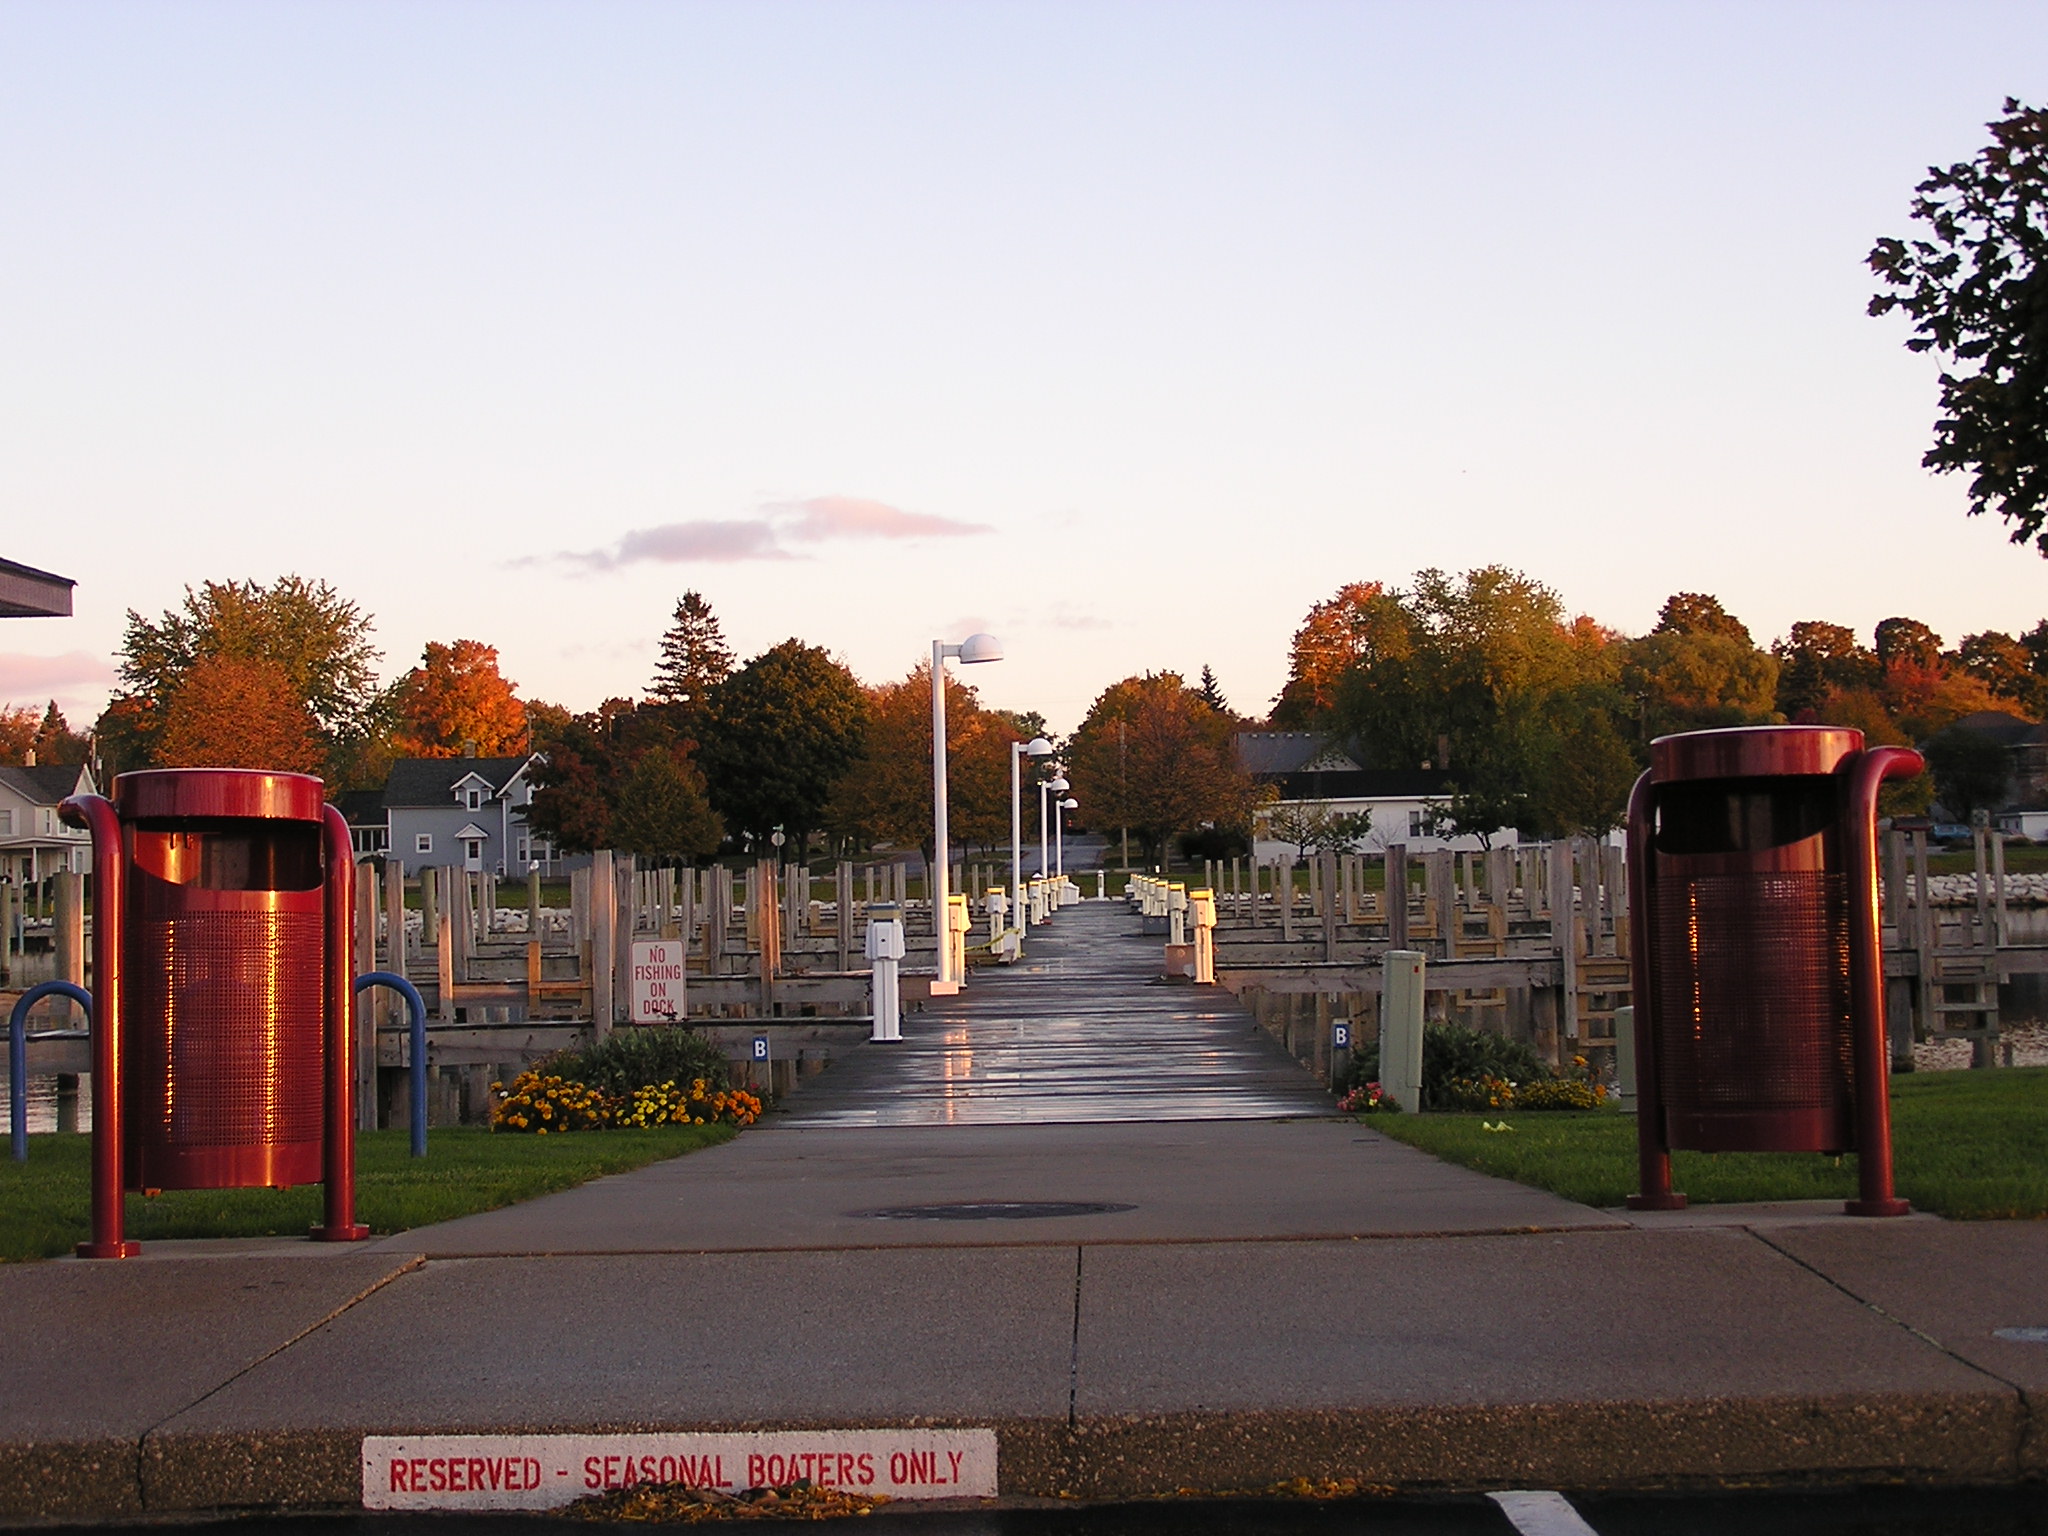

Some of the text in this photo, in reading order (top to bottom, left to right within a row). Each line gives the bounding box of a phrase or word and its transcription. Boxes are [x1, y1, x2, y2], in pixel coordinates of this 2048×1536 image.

[649, 948, 665, 963] NO
[635, 965, 681, 980] FISHING
[650, 982, 666, 997] ON
[643, 1000, 674, 1015] DOCK
[1336, 1027, 1347, 1045] B
[754, 1041, 766, 1057] B
[389, 1455, 541, 1493] RESERVED
[584, 1453, 733, 1490] SEASONAL
[748, 1451, 875, 1488] BOATERS
[890, 1449, 965, 1486] ONLY
